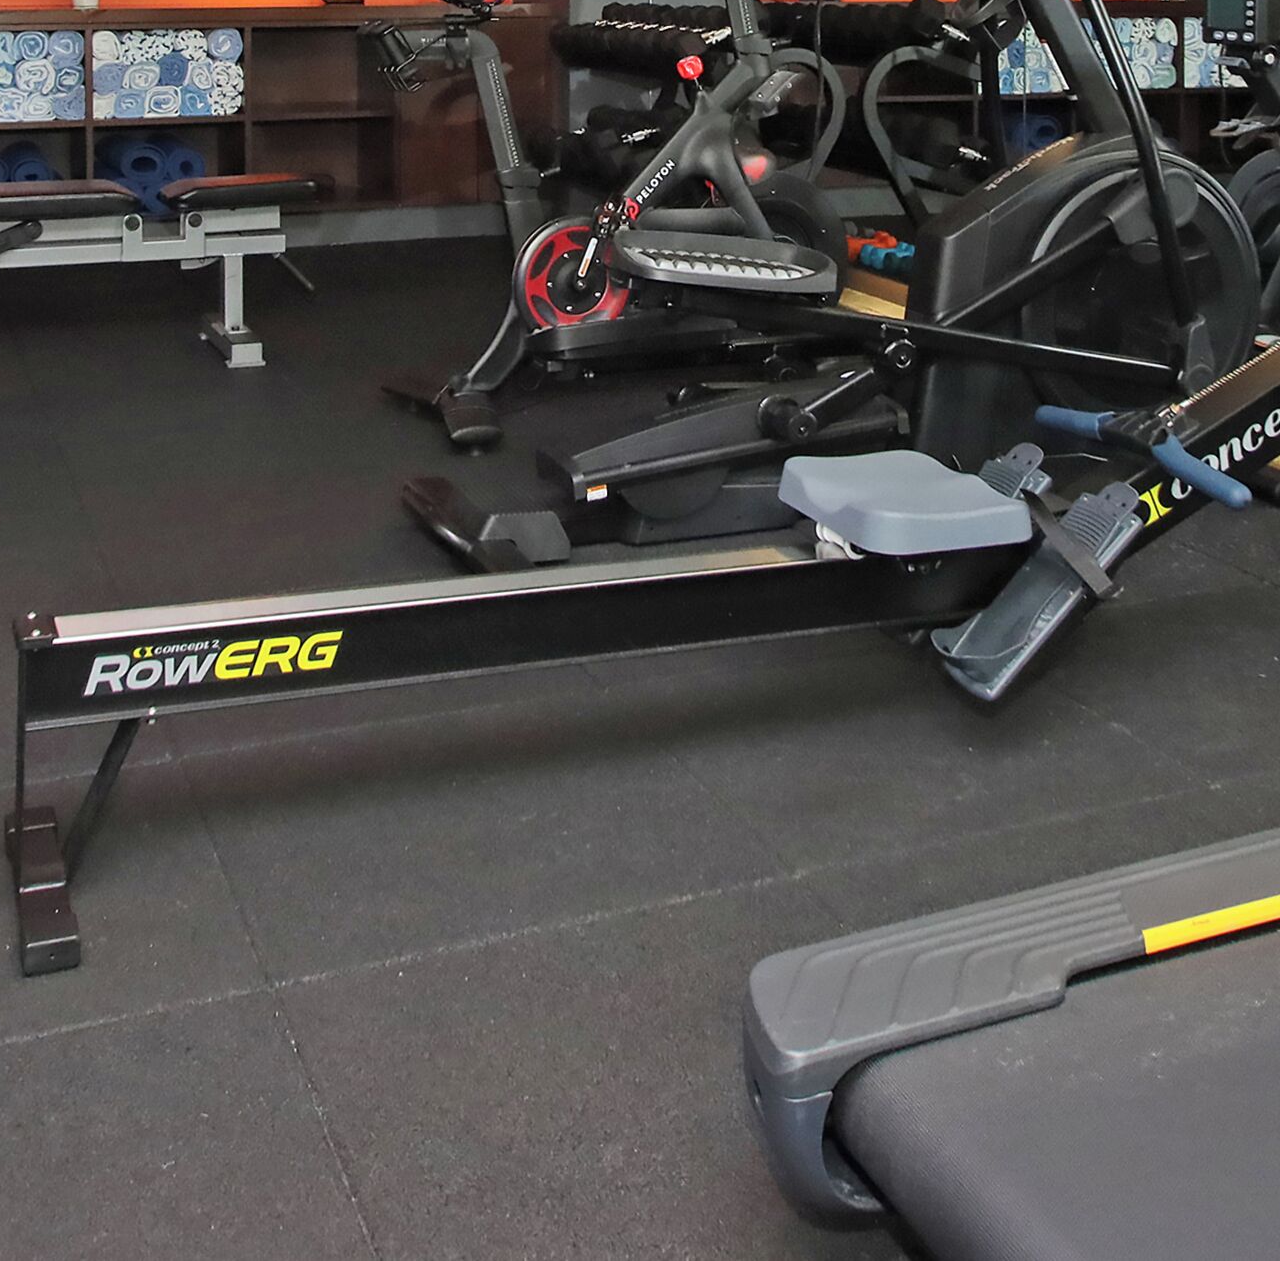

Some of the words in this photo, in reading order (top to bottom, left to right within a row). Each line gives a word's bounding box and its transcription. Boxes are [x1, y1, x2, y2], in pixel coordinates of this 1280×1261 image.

[636, 159, 676, 205] PELOTON
[153, 640, 210, 656] concept
[211, 639, 221, 650] 2
